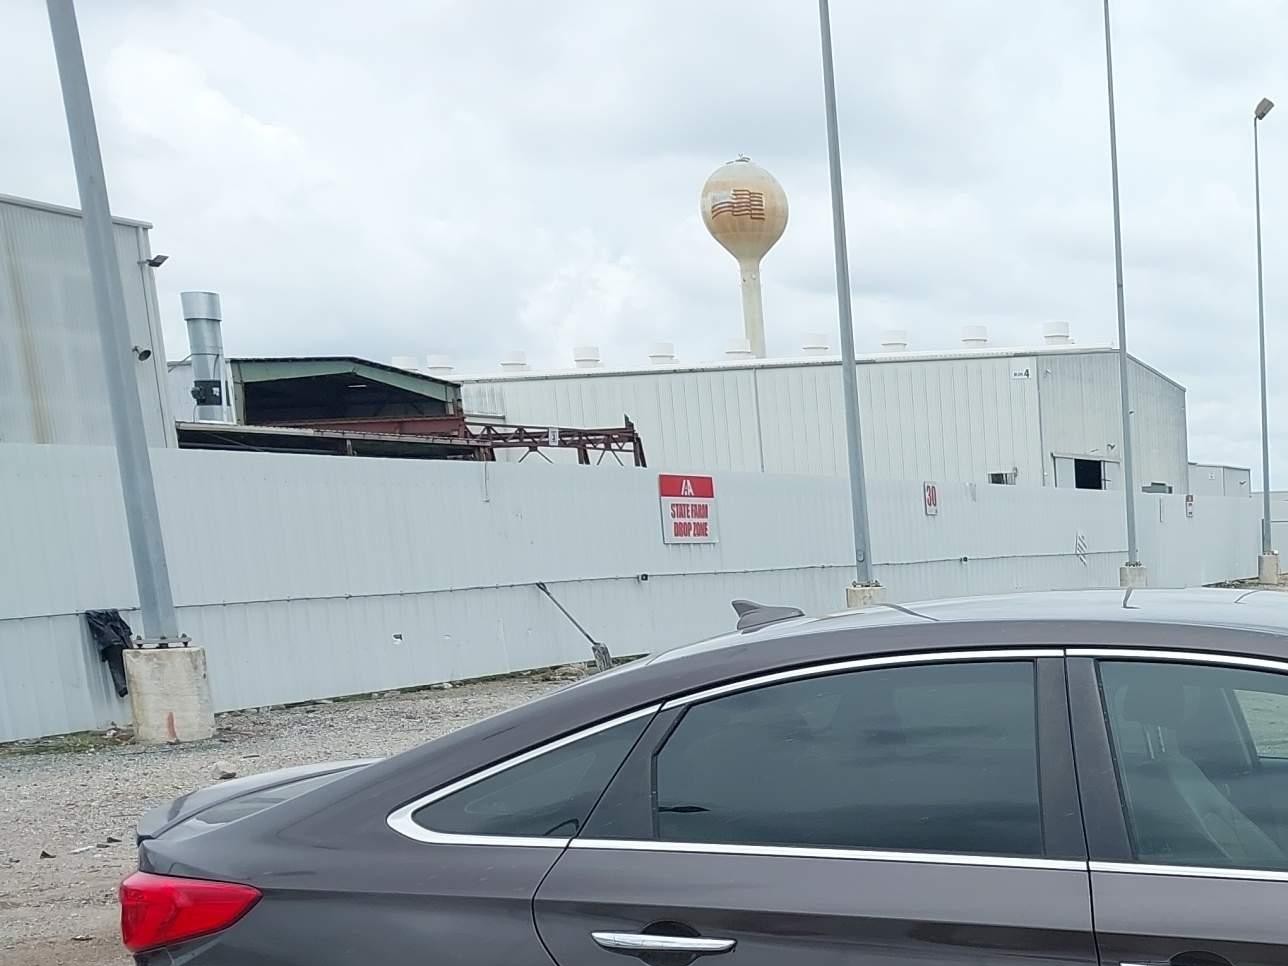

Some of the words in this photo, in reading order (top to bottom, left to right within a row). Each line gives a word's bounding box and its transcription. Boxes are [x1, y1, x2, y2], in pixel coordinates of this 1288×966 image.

[926, 485, 937, 507] 30
[670, 503, 690, 519] STATE
[691, 503, 708, 519] FARM
[673, 521, 692, 537] DROP
[693, 521, 709, 537] ZONE
